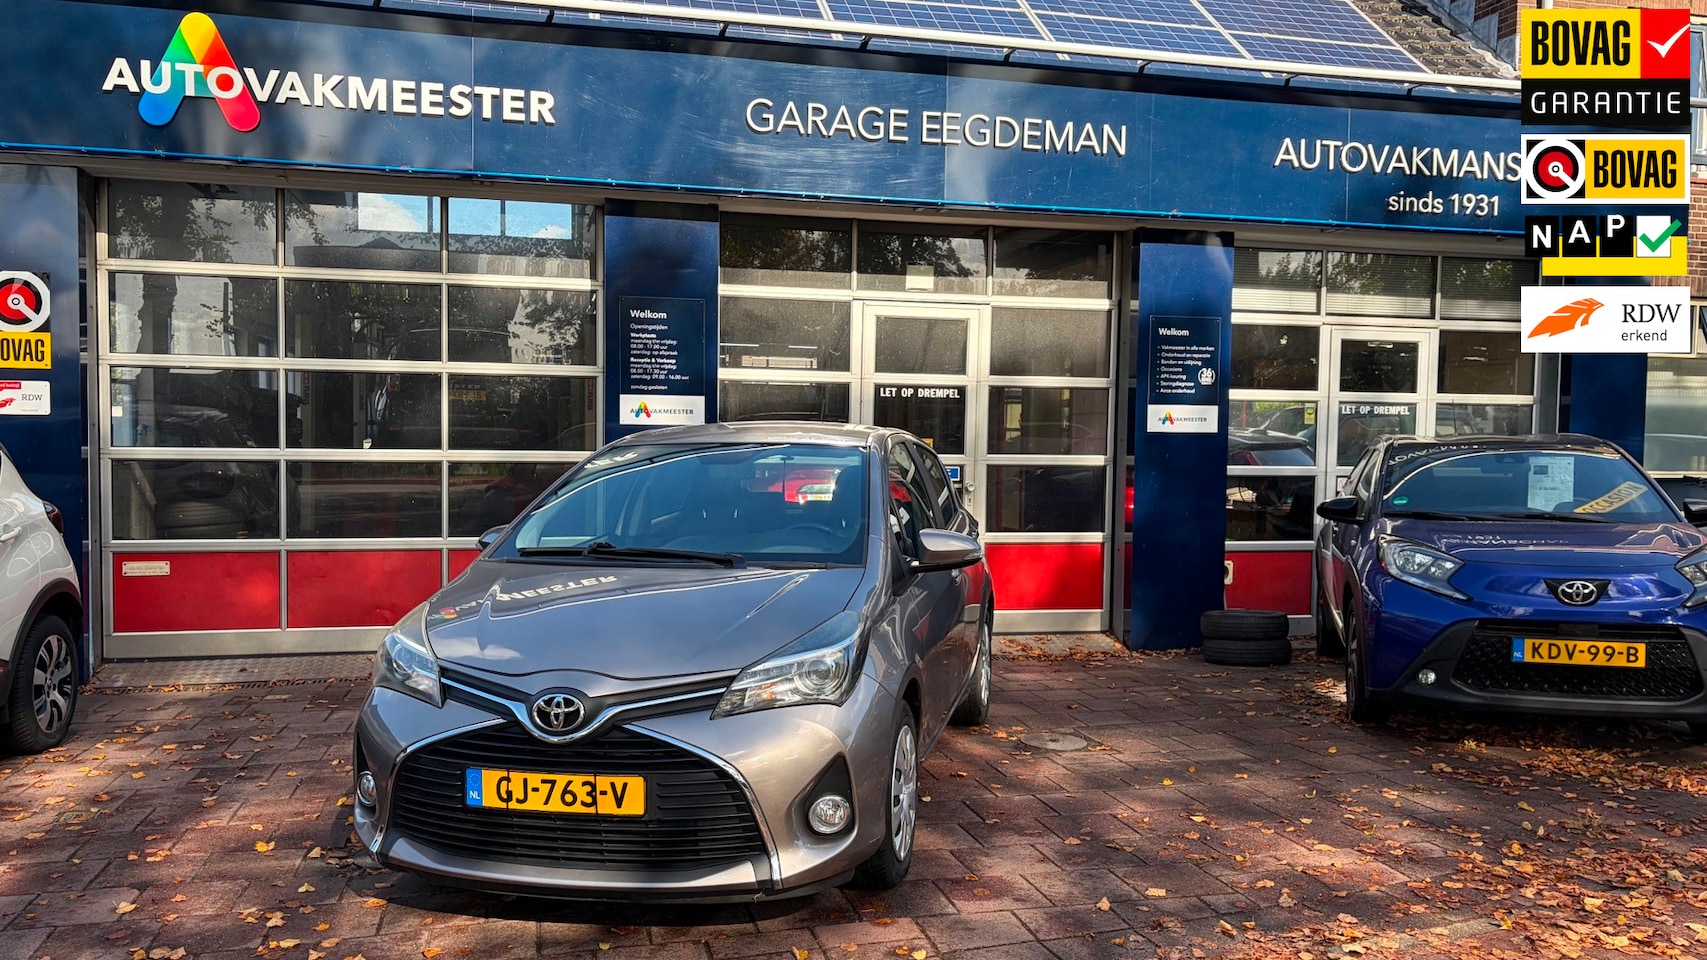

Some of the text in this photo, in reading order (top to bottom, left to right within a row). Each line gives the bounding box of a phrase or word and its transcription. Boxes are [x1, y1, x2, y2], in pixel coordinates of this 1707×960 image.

[102, 57, 557, 126] AUTOVAKMEESTER
[745, 98, 1127, 157] GARAGE EEGDEMAN
[1387, 190, 1499, 216] sinds 1931
[629, 309, 667, 319] Welkom
[630, 323, 668, 331] Openingstijden
[1158, 328, 1189, 336] Welkom
[1200, 368, 1212, 377] 36
[880, 387, 960, 399] LET OP DREMPEL
[1341, 405, 1410, 415] LET OP DREMPEL
[1513, 641, 1640, 664] NL KDV-99-B
[469, 776, 629, 809] NL GJ-763-V
